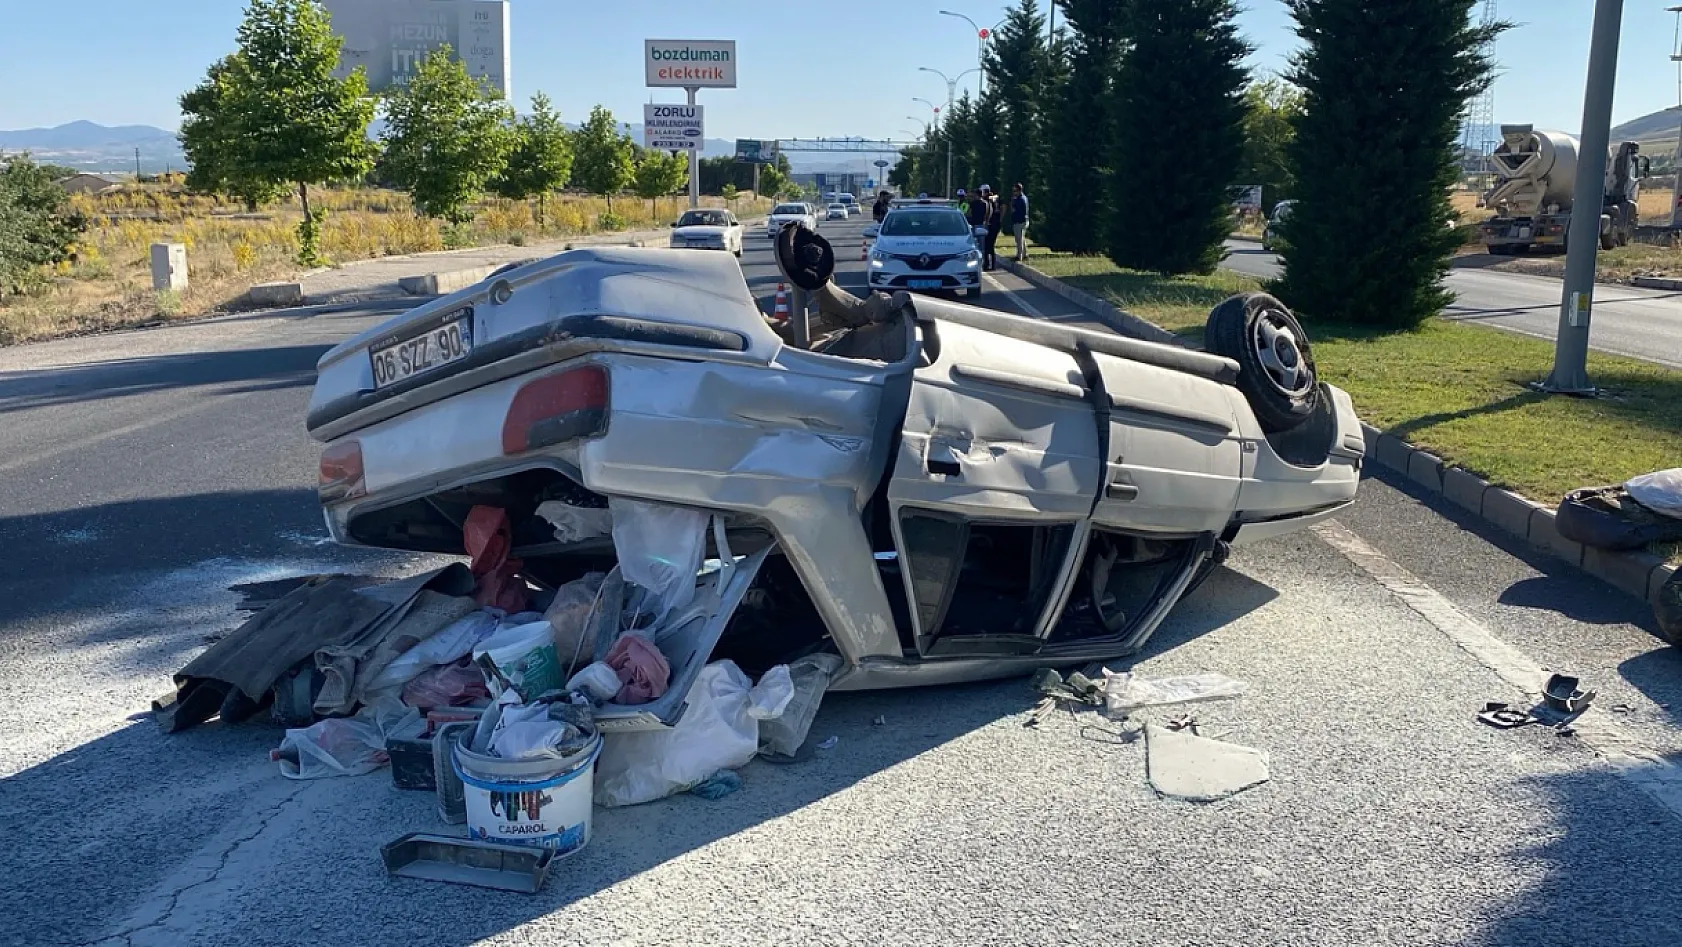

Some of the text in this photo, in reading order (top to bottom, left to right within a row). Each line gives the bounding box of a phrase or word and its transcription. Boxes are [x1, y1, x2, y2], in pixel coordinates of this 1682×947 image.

[652, 47, 729, 62] bozduman
[658, 67, 724, 80] elektrik
[654, 107, 695, 118] ZORLU
[375, 352, 396, 383] 06
[400, 337, 431, 375] SZZ
[438, 326, 461, 360] 90
[498, 823, 547, 834] CAPAROL
